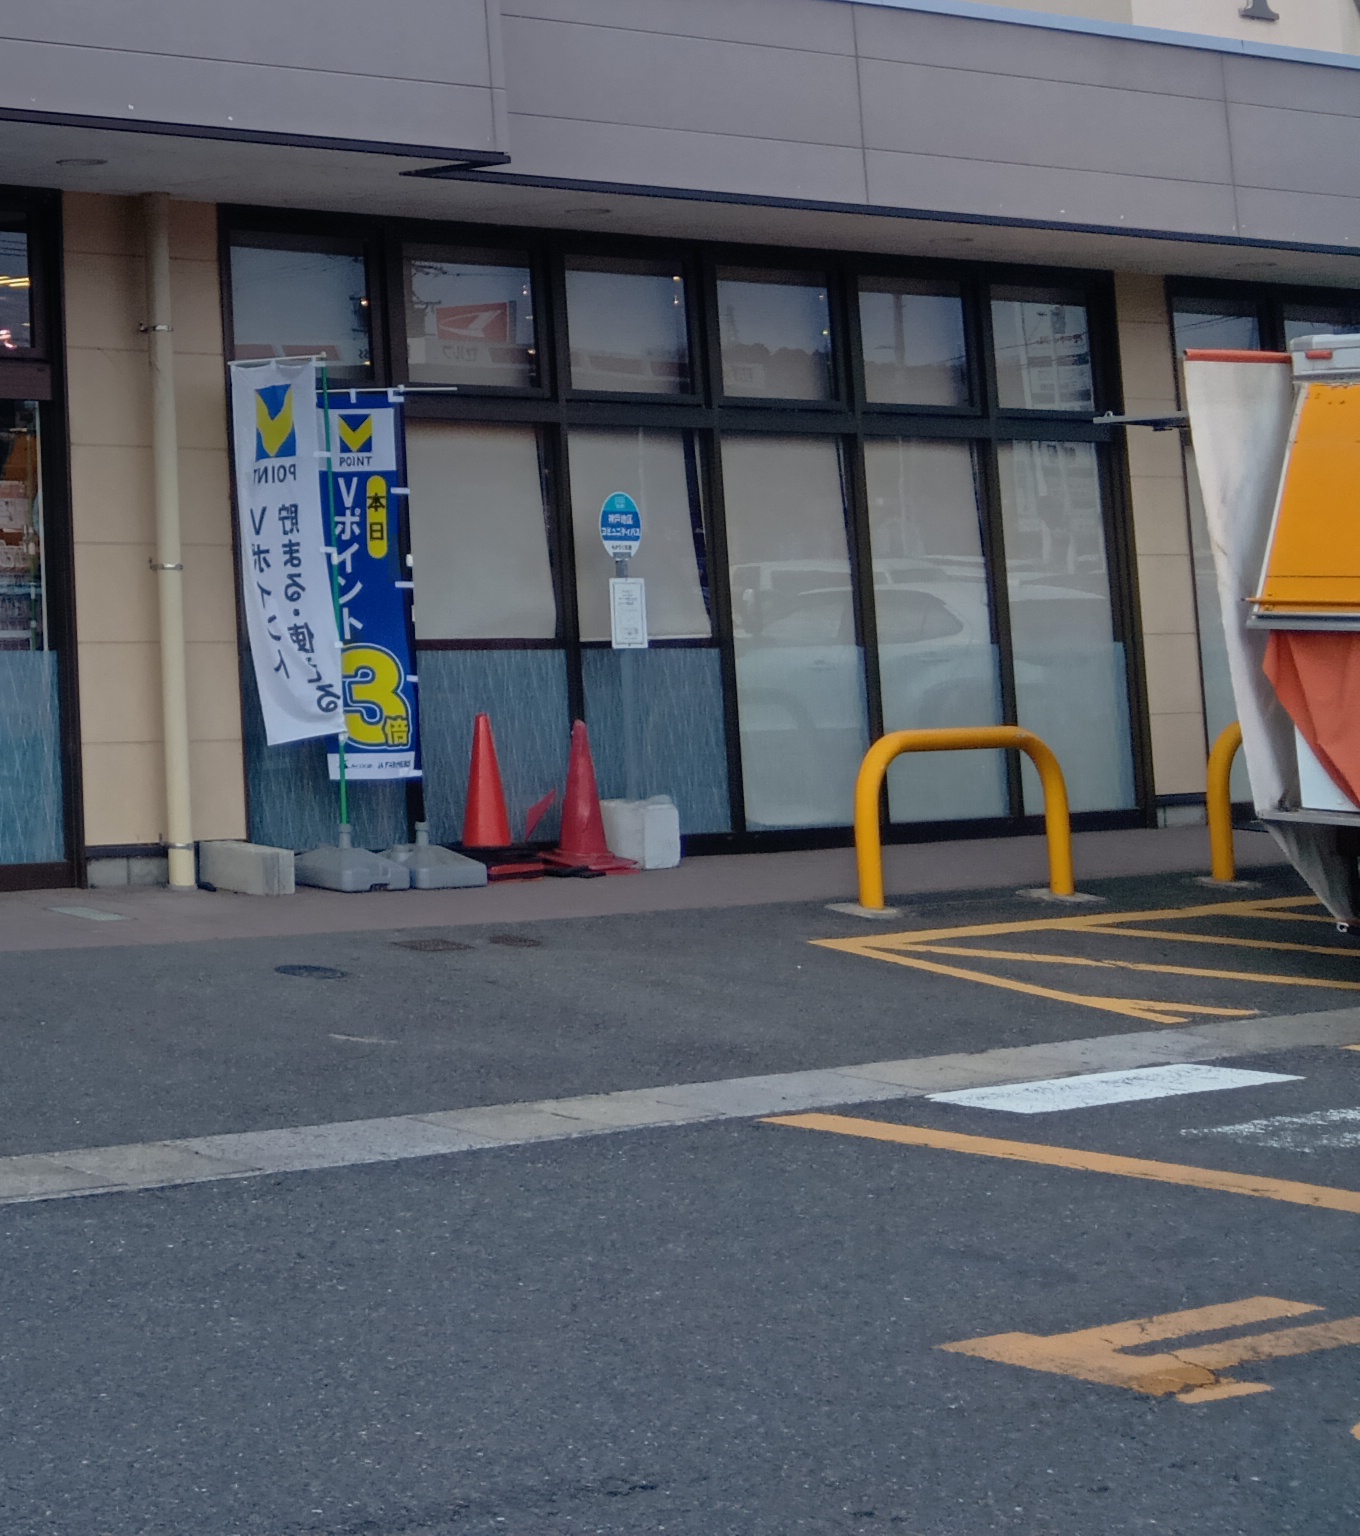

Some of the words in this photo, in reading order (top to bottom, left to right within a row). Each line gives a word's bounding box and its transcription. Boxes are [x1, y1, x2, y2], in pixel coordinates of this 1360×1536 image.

[339, 456, 373, 467] POINT
[366, 493, 386, 542] 本日
[334, 477, 363, 640] Vポイント
